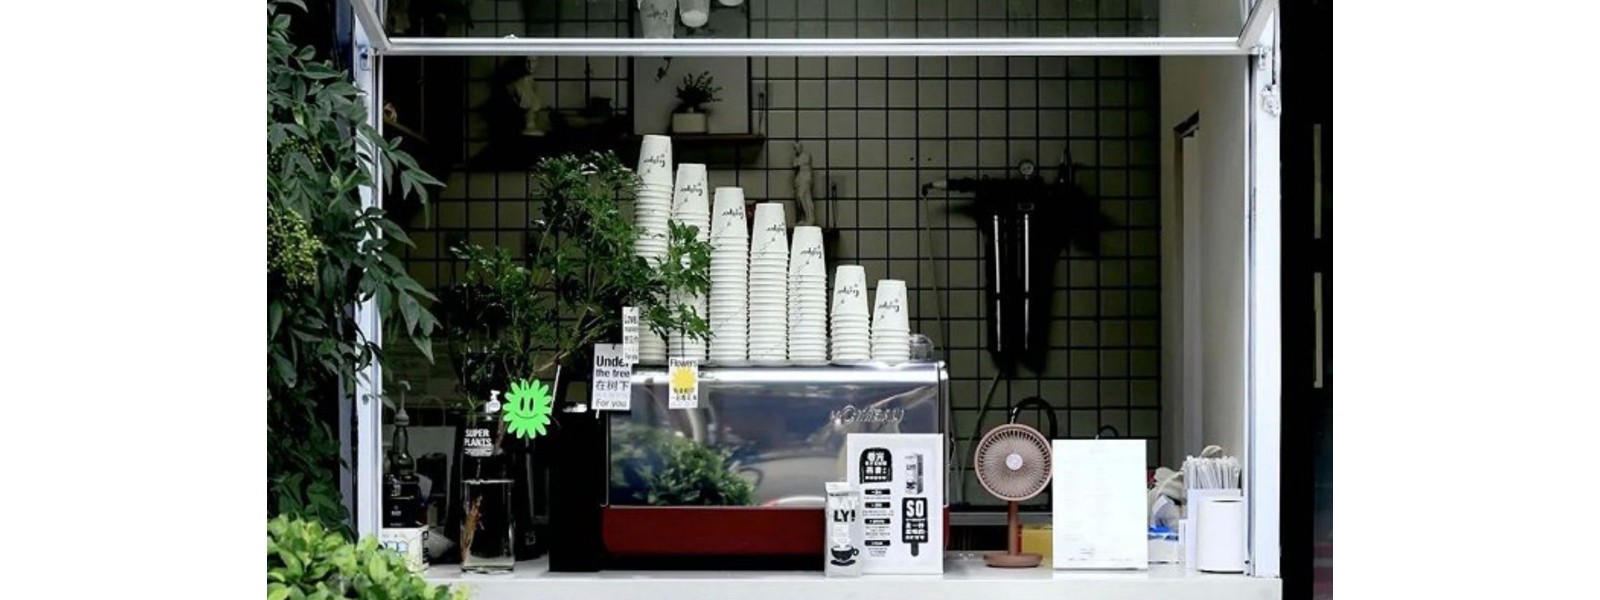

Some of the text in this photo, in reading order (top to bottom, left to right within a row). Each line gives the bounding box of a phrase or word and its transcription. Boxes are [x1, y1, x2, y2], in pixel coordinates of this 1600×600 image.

[596, 356, 629, 367] Unde
[596, 369, 630, 378] the tree
[596, 381, 629, 391] 在树下
[465, 428, 490, 437] SUPER
[464, 438, 492, 446] PLANTS
[906, 500, 924, 518] SO
[834, 509, 856, 522] LY!
